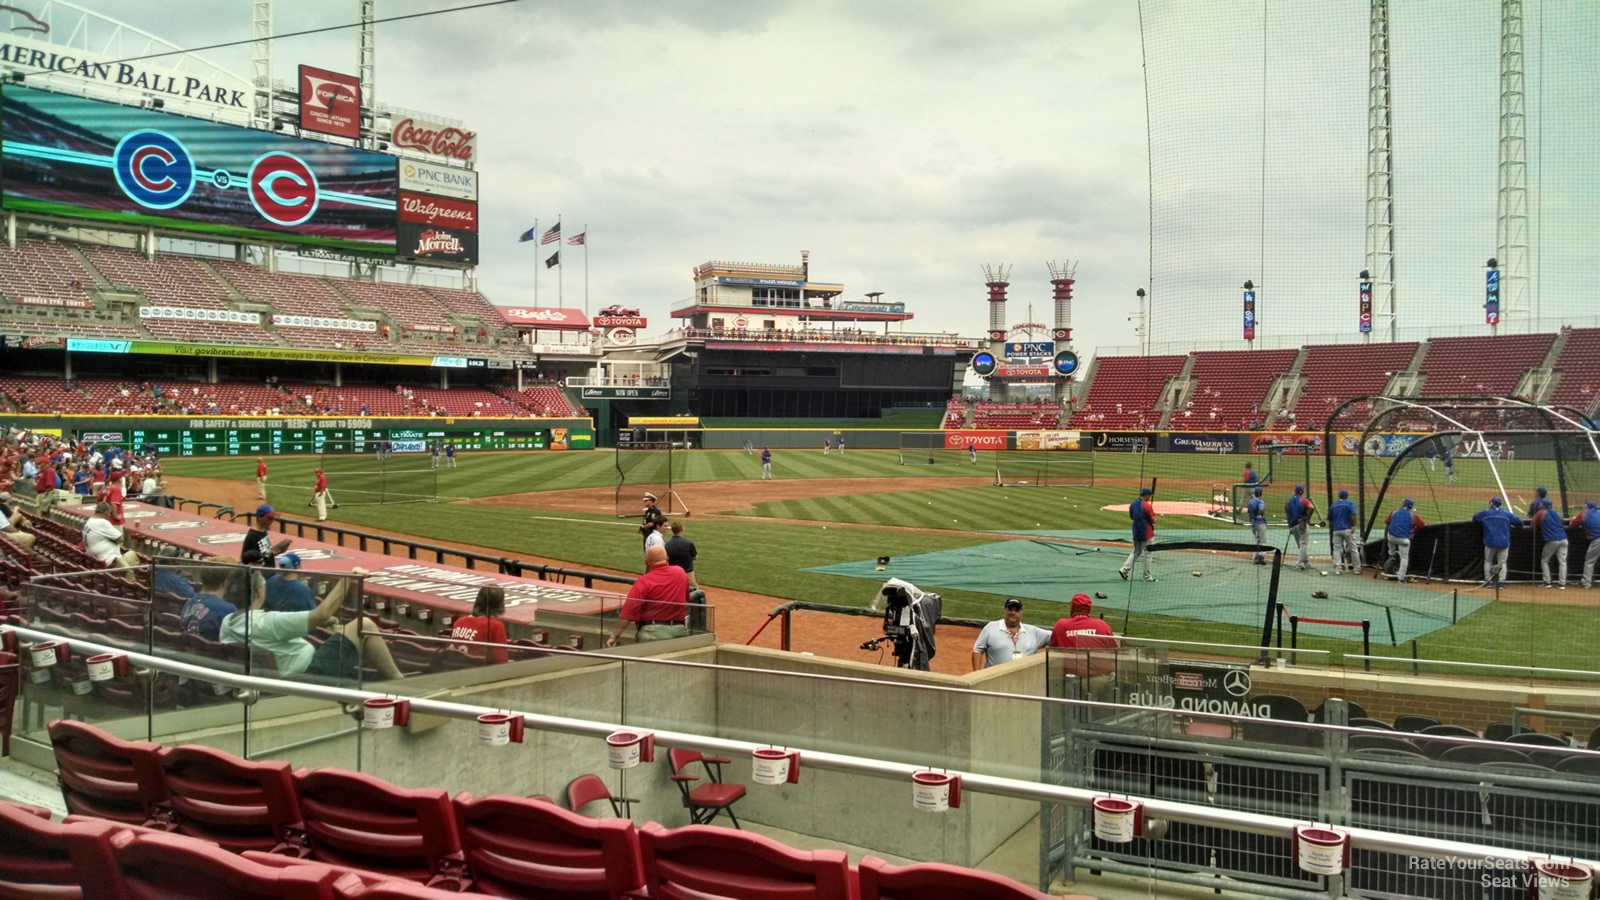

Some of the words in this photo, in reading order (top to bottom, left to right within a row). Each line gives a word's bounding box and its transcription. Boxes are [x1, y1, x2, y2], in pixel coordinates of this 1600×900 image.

[418, 168, 441, 181] PNC
[443, 173, 472, 187] BANK
[402, 198, 474, 221] Walgreens
[432, 231, 452, 241] John
[414, 238, 464, 254] Morrell
[301, 250, 341, 261] ULTIMATE
[356, 257, 393, 267] SHUTTLE
[174, 346, 192, 354] Visit
[195, 347, 254, 357] govibrant.com
[256, 349, 268, 358] for
[270, 350, 283, 359] fun
[284, 352, 302, 360] ways
[314, 353, 331, 361] stay
[332, 354, 353, 362] active
[1023, 344, 1046, 352] PNC
[190, 420, 204, 428] FOR
[205, 420, 230, 428] SAFETY
[238, 420, 266, 428] SERVICE
[267, 420, 282, 428] TEXT
[319, 420, 337, 428] ISSUE
[338, 420, 347, 428] TO
[347, 419, 372, 429] 69050
[964, 436, 1003, 445] TOYOTA
[1066, 628, 1097, 640] SECURITY
